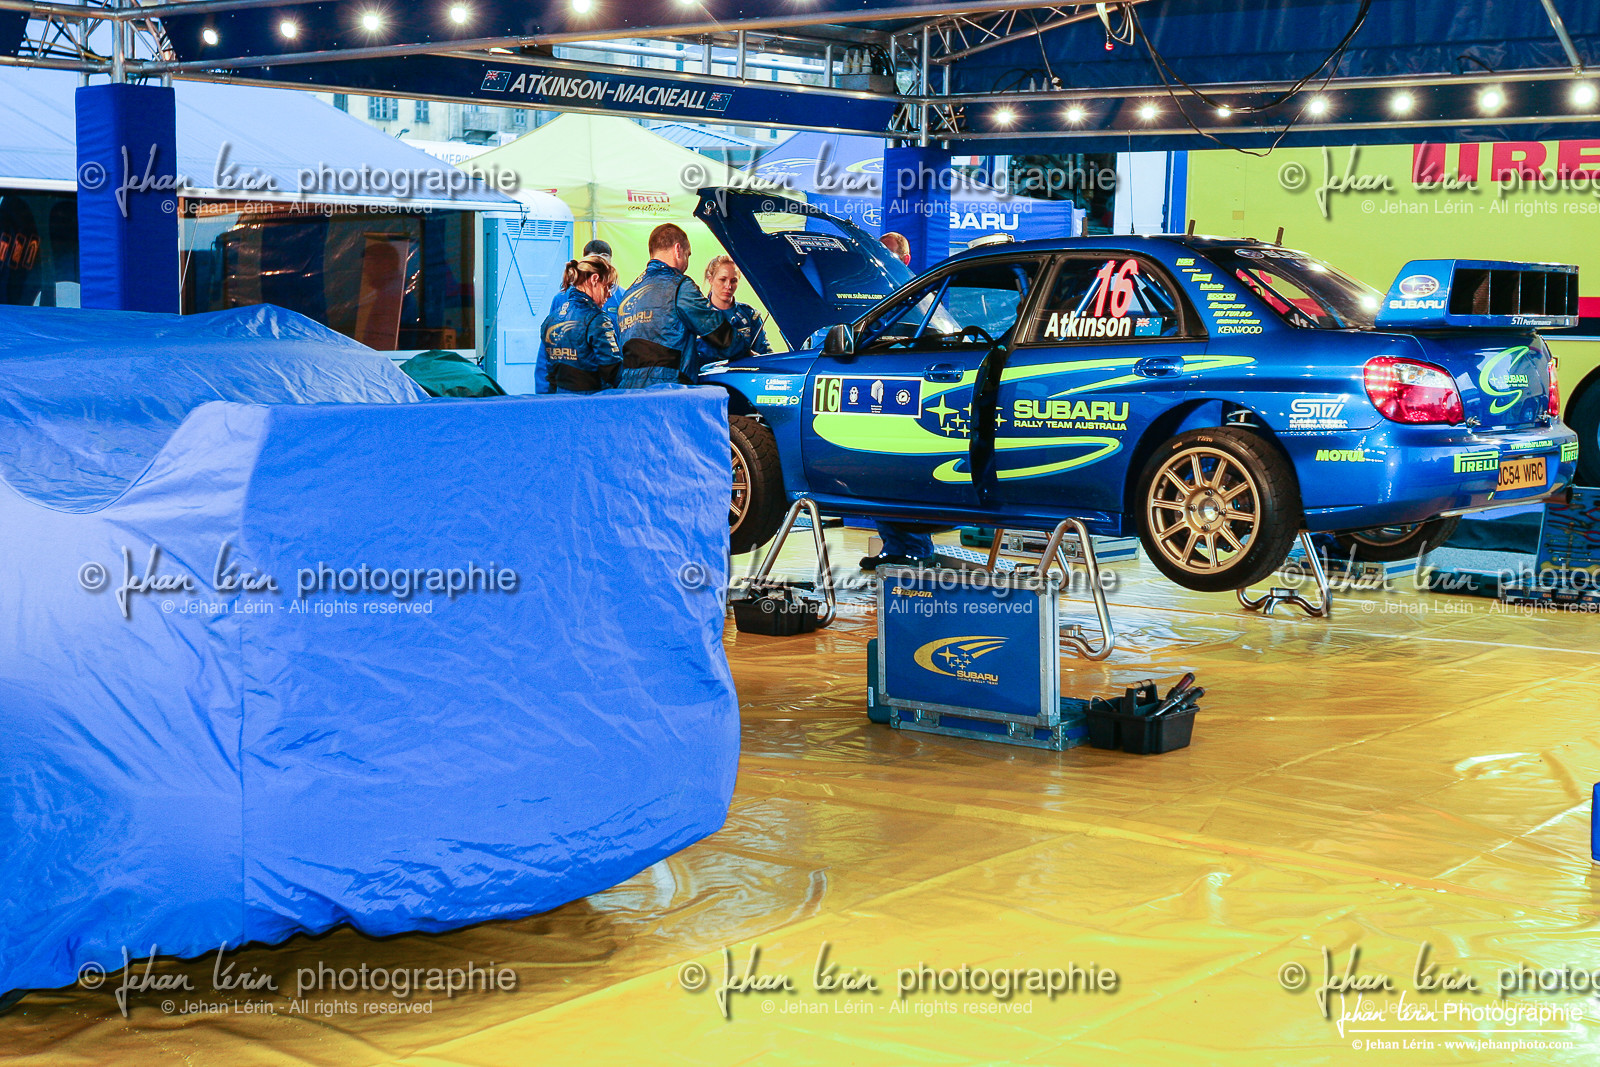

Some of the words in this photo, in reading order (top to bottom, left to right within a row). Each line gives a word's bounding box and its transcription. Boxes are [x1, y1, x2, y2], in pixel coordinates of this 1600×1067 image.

[509, 74, 707, 110] ATKINSON-MACNEALL
[627, 189, 670, 203] PIRELLI
[1093, 258, 1140, 318] 16
[1389, 299, 1446, 310] SUBARU
[1044, 312, 1131, 338] Atkinson
[1218, 325, 1263, 334] KENWOOD
[816, 378, 840, 412] 16
[1014, 399, 1130, 422] SUBARU
[1013, 420, 1045, 429] RALLY
[1046, 421, 1073, 430] TEAM
[1074, 422, 1128, 432] AUSTRALIA
[1315, 449, 1366, 462] MOTUL
[1454, 451, 1499, 473] PIRELLI
[1523, 461, 1544, 482] WRC
[956, 670, 999, 682] SUBARU
